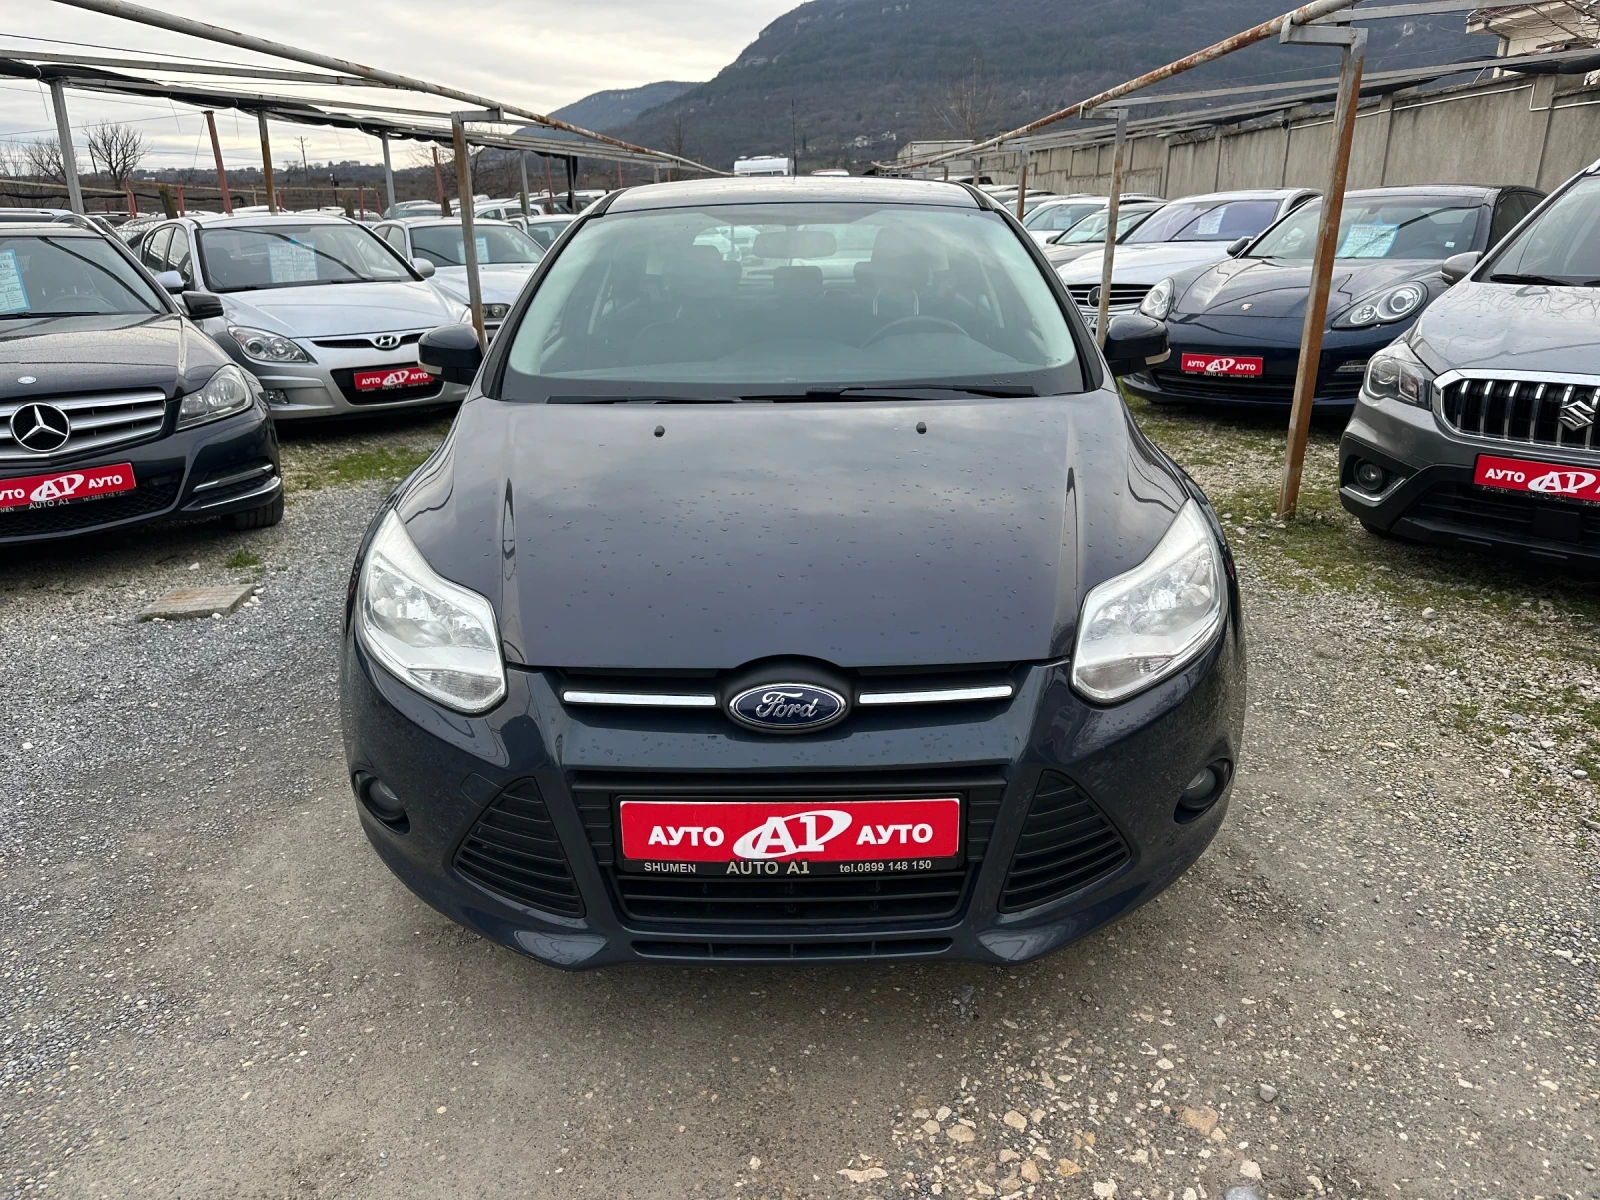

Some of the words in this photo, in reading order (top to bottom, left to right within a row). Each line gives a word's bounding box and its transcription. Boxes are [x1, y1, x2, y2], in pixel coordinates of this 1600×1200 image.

[1235, 363, 1256, 371] АУТО
[88, 475, 123, 489] АУТО
[1485, 468, 1526, 483] АУТО
[28, 499, 55, 510] AUTO
[58, 498, 70, 506] A1
[756, 691, 819, 717] Ford
[648, 825, 725, 847] АУТО
[856, 823, 934, 845] АУТО
[644, 862, 696, 873] SHUMEN
[726, 861, 779, 875] AUTO
[786, 861, 810, 875] A1
[839, 861, 885, 873] tel.0899
[888, 861, 908, 871] 148
[912, 860, 932, 870] 150
